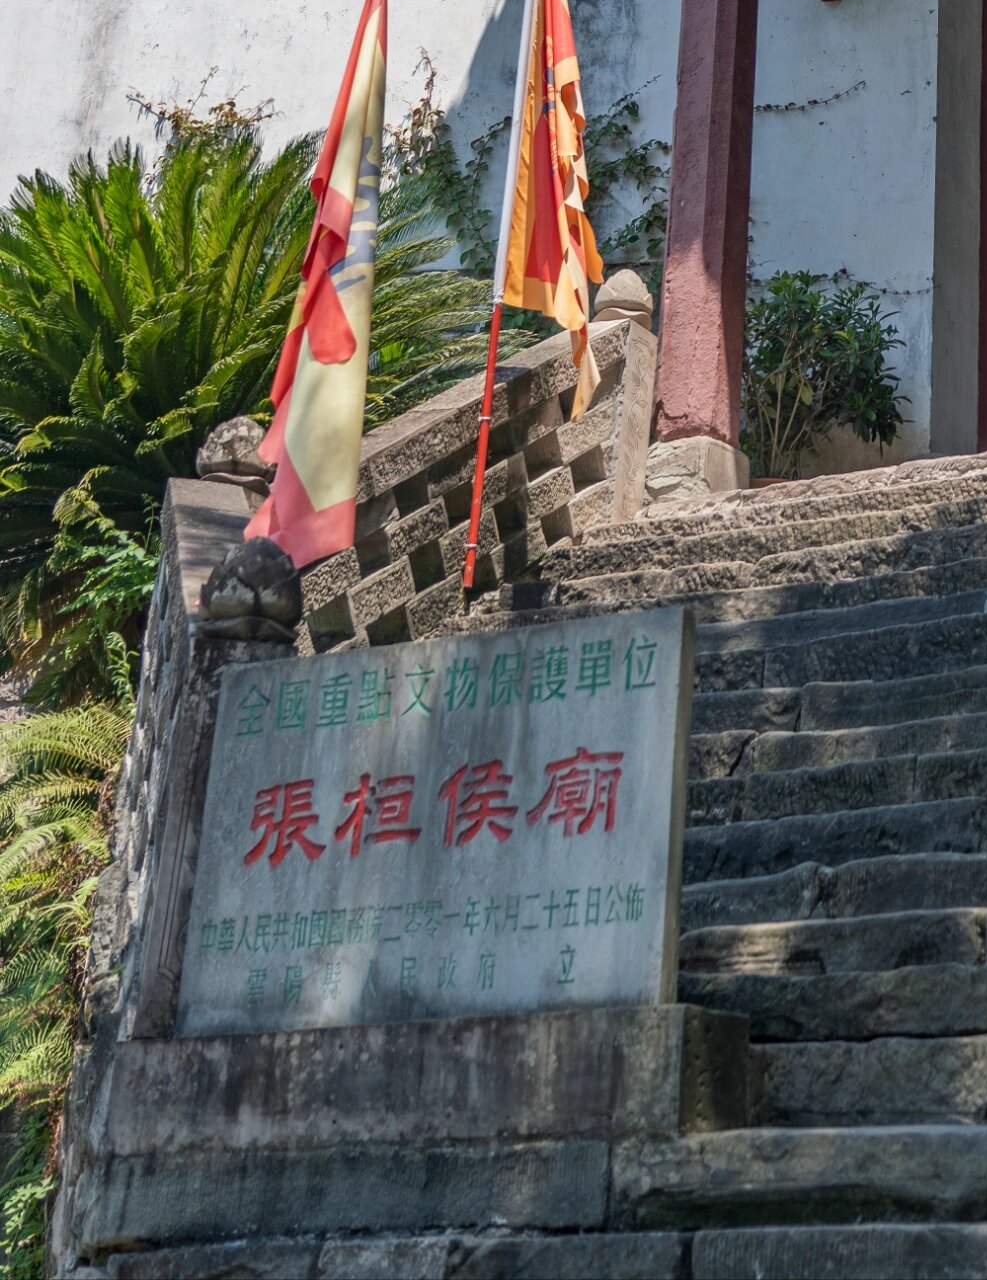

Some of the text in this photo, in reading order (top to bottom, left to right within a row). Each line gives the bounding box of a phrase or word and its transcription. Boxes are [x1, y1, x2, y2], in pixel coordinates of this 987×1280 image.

[236, 634, 659, 738] 全國重點文物保護單位
[243, 746, 625, 869] 張桓侯廟
